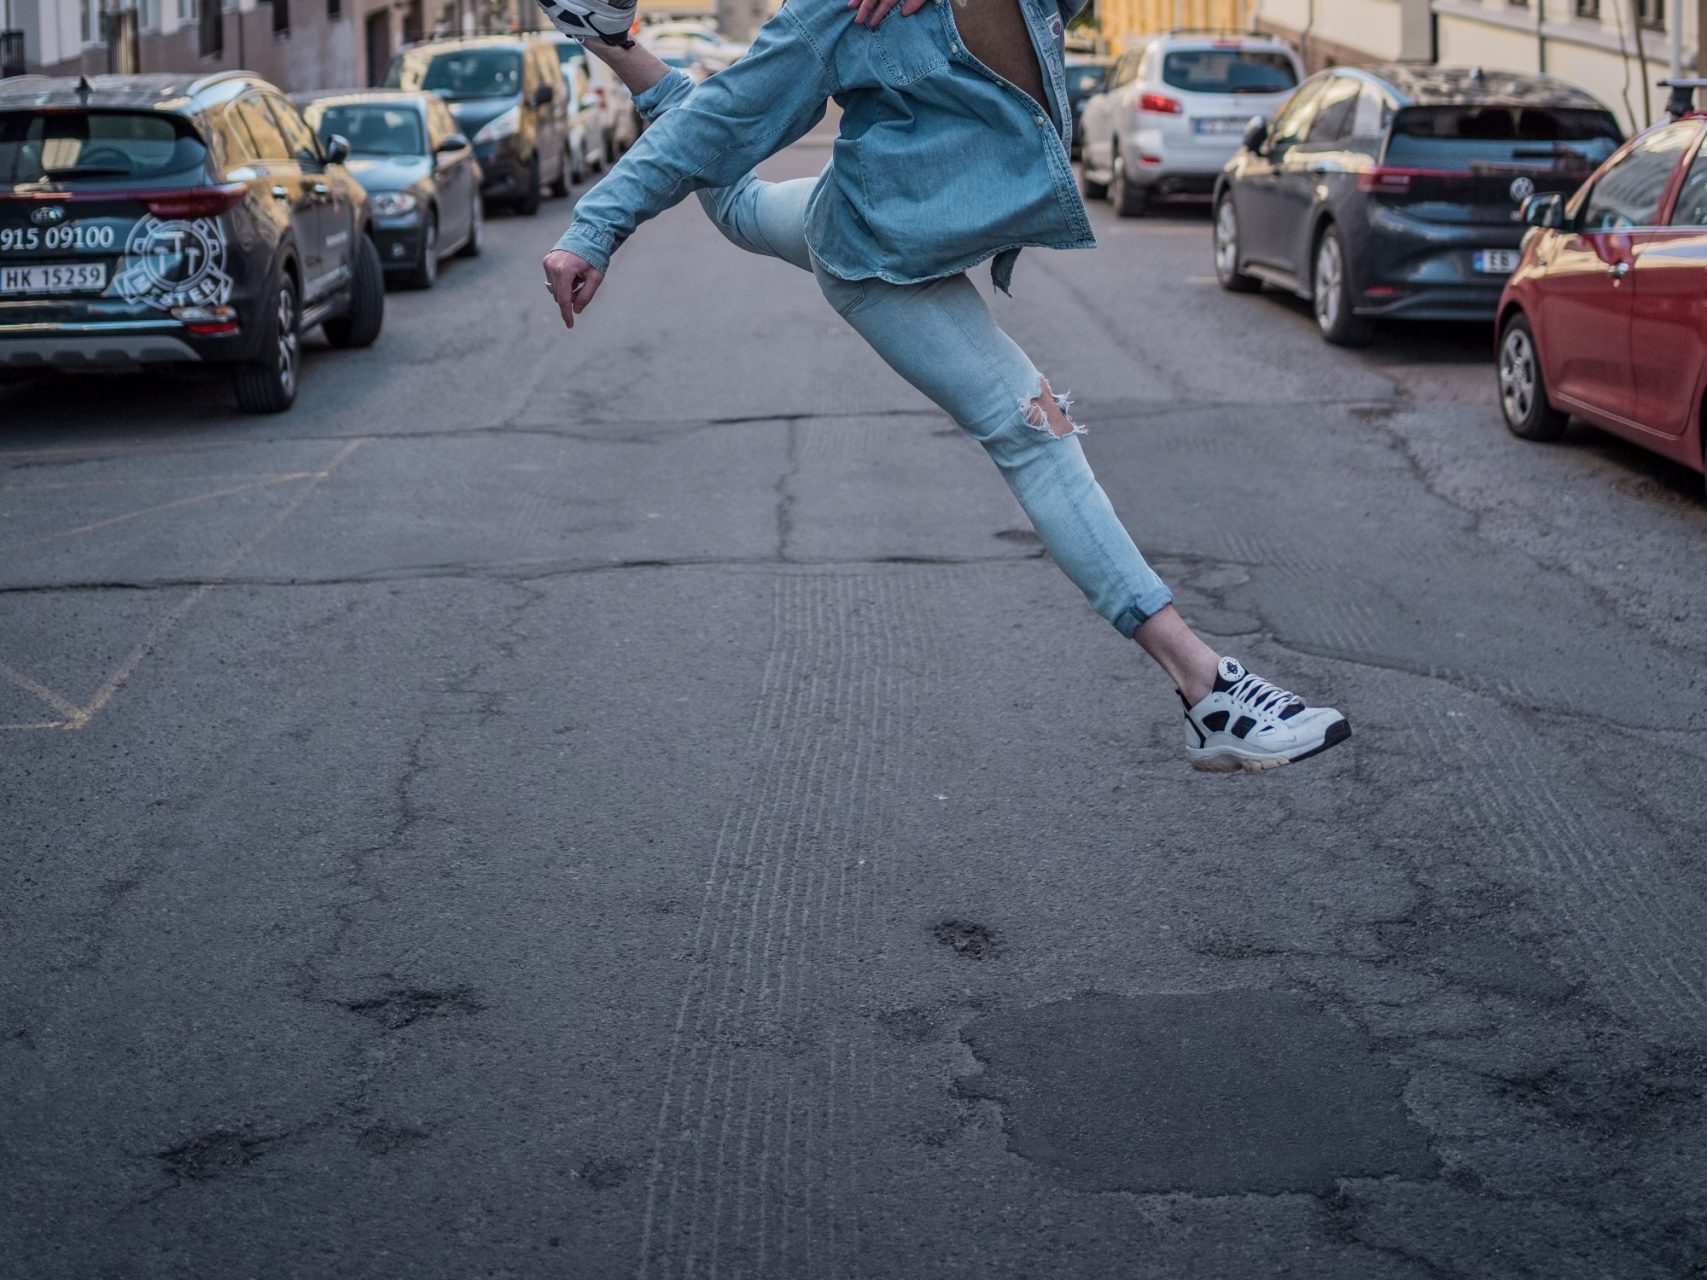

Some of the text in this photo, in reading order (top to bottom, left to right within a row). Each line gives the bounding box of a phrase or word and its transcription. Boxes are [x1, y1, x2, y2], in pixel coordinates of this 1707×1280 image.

[0, 225, 115, 251] 915 09100
[6, 266, 101, 288] HK 15259
